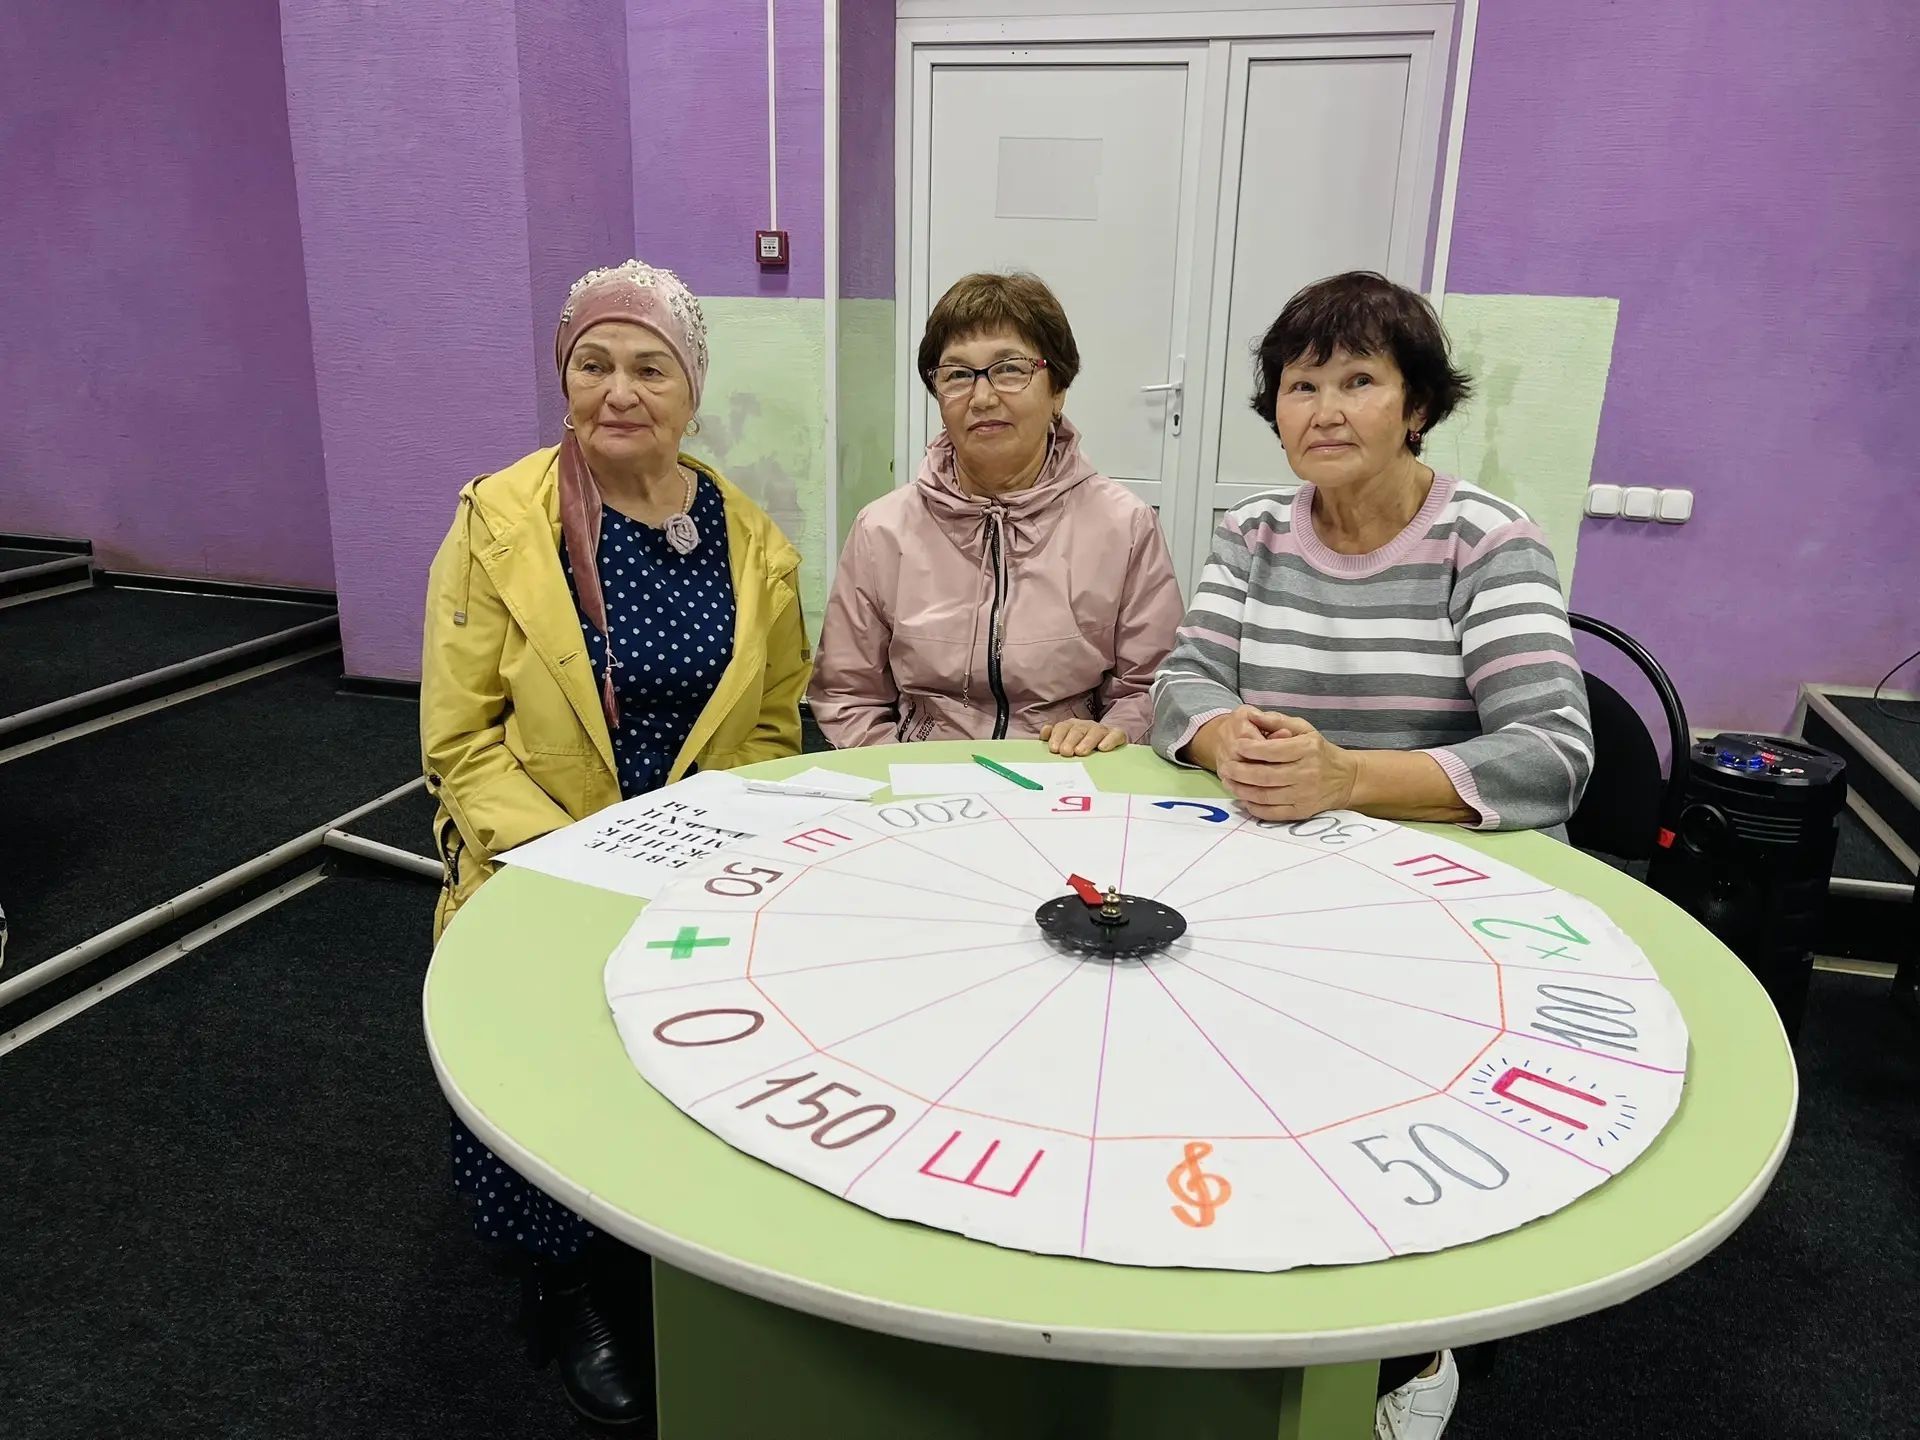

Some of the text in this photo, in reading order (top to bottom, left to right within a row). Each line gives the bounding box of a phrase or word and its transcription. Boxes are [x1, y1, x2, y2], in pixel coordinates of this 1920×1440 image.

[878, 798, 988, 828] 200
[704, 862, 784, 898] 50
[1530, 983, 1638, 1051] 100
[736, 1071, 896, 1149] 150
[1351, 1123, 1510, 1205] 50
